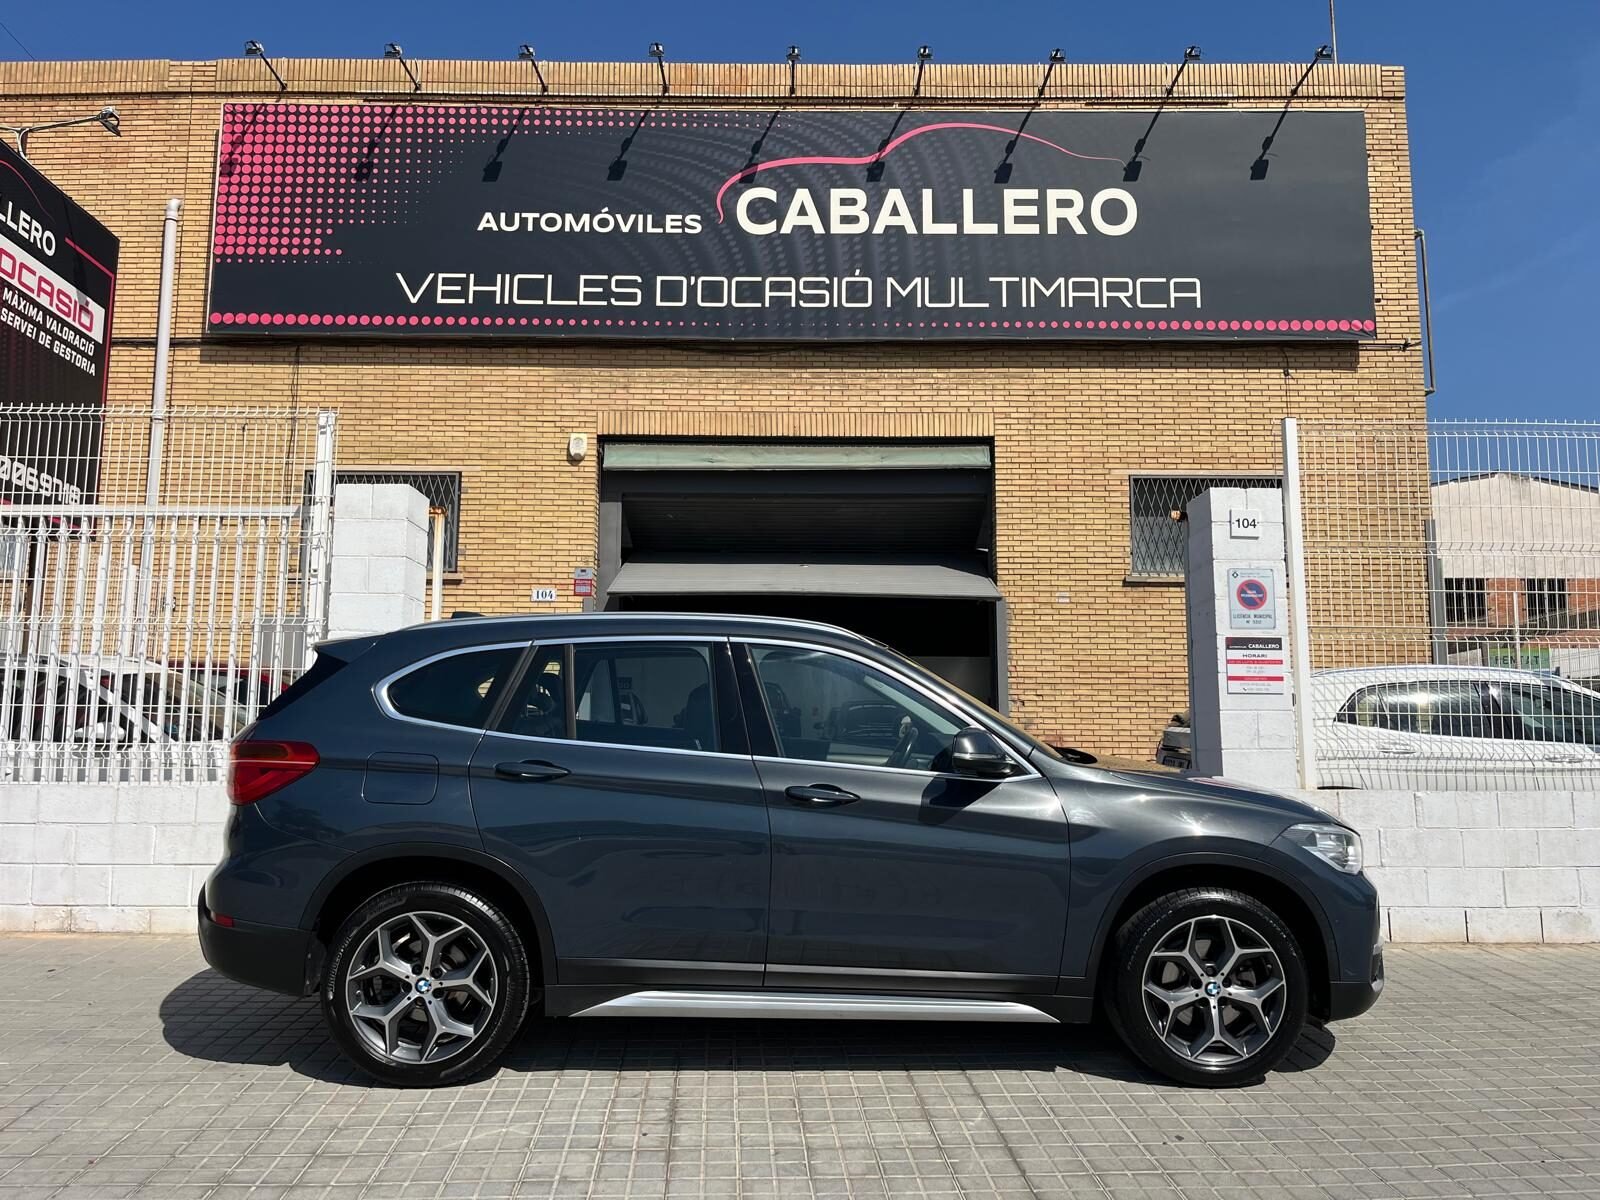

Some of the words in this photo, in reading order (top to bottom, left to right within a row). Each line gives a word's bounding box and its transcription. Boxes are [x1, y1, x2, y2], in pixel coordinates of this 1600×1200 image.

[477, 206, 702, 234] AUTOMÓVILES
[736, 187, 1139, 236] CABALLERO
[395, 272, 642, 306] VEHICLES
[656, 269, 873, 308] D'OCASIÓ
[886, 276, 1202, 309] MULTIMARCA
[0, 307, 37, 340] SERVEI
[38, 331, 52, 349] DE
[53, 340, 96, 377] GESTORIA
[3, 287, 43, 325] MÀXIMA
[46, 315, 95, 357] VALORACIÓ
[1235, 518, 1257, 528] 104
[536, 590, 553, 599] 104
